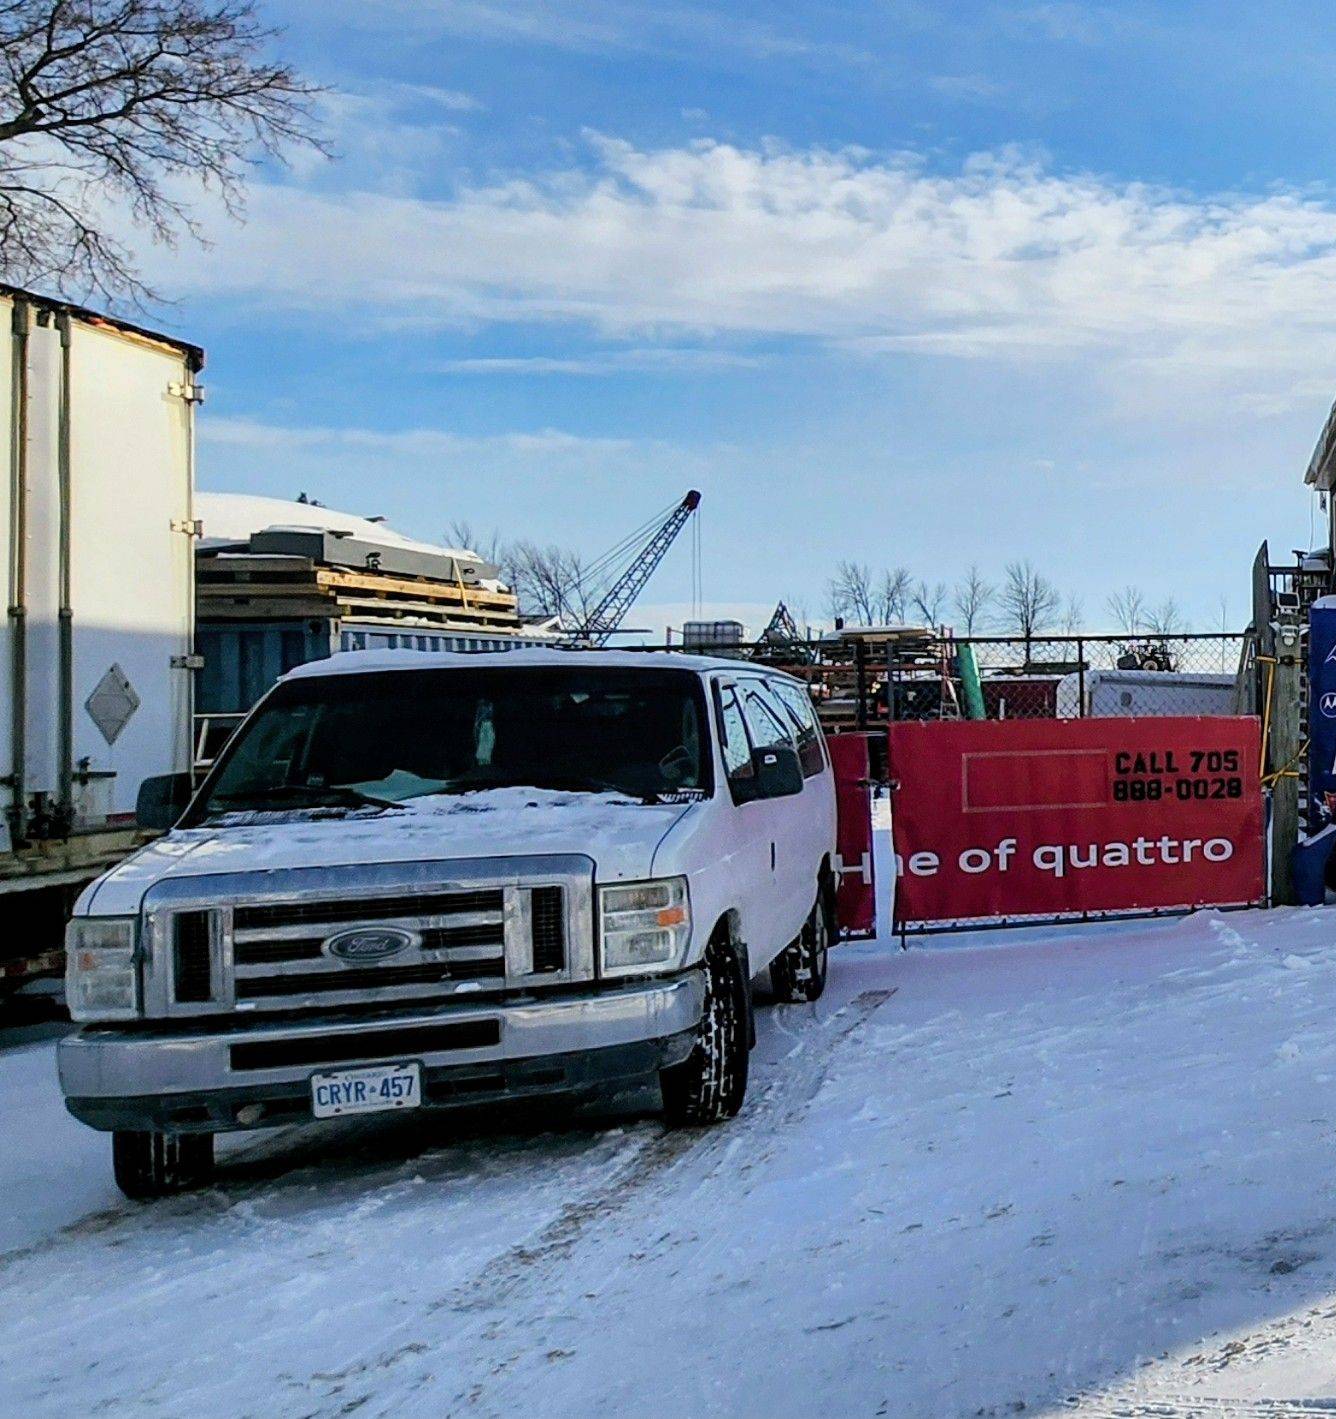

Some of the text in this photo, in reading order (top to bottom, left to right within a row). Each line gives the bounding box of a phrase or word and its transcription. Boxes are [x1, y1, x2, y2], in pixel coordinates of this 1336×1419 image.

[1115, 750, 1239, 774] CALL 705
[1113, 777, 1242, 801] 888-0028
[958, 838, 1017, 873] of
[1032, 835, 1233, 877] quattro
[316, 1081, 367, 1106] CRYR
[379, 1076, 414, 1098] 457
